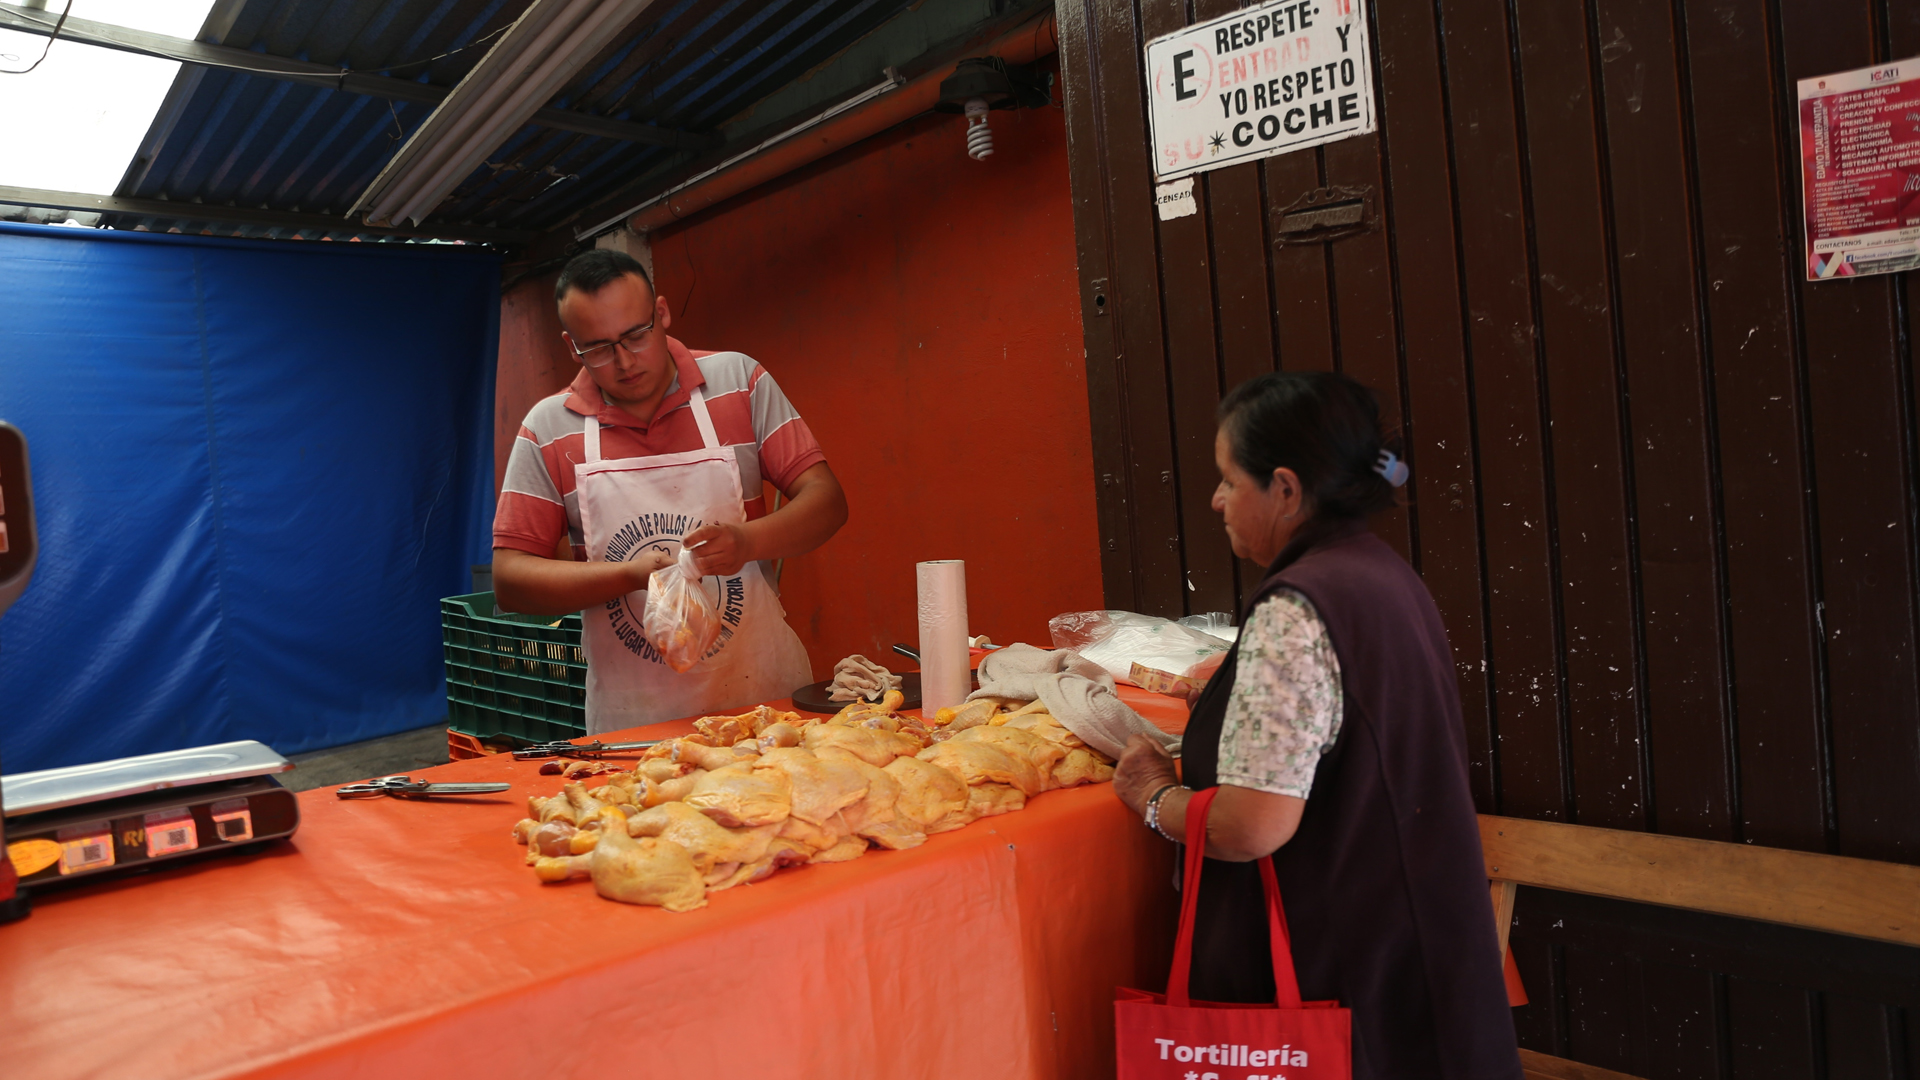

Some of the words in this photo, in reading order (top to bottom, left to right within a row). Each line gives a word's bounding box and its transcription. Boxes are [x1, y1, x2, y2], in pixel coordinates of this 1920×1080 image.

[1215, 0, 1313, 55] RESPETE
[1218, 36, 1313, 88] ENTRAD
[1336, 24, 1350, 52] Y
[1173, 50, 1197, 101] E
[1219, 88, 1247, 119] YO
[1253, 58, 1355, 111] RESPETO
[1838, 92, 1862, 103] ARTES
[1863, 86, 1900, 99] GRÁFICAS
[1839, 97, 1886, 112] CARPINTERÍA
[1839, 107, 1876, 120] CREACIÓN
[1164, 133, 1204, 166] SU
[1232, 93, 1360, 147] COCHE
[1840, 117, 1873, 128] PRENDAS
[1840, 122, 1891, 136] ELECTRICIDAD
[1840, 130, 1890, 144] ELECTRÓNICA
[1841, 137, 1893, 152] GASTRONOMÍA
[1841, 148, 1878, 161] MECÁNICA
[1842, 157, 1877, 169] SISTEMAS
[1842, 165, 1886, 177] SOLDADURA
[1887, 162, 1897, 170] EN
[638, 514, 654, 538] DE
[653, 512, 687, 536] POLLOS
[722, 576, 744, 627] HISTORIA
[609, 608, 624, 628] EL
[615, 621, 646, 656] LUGAR
[1154, 1038, 1308, 1067] Tortillería
